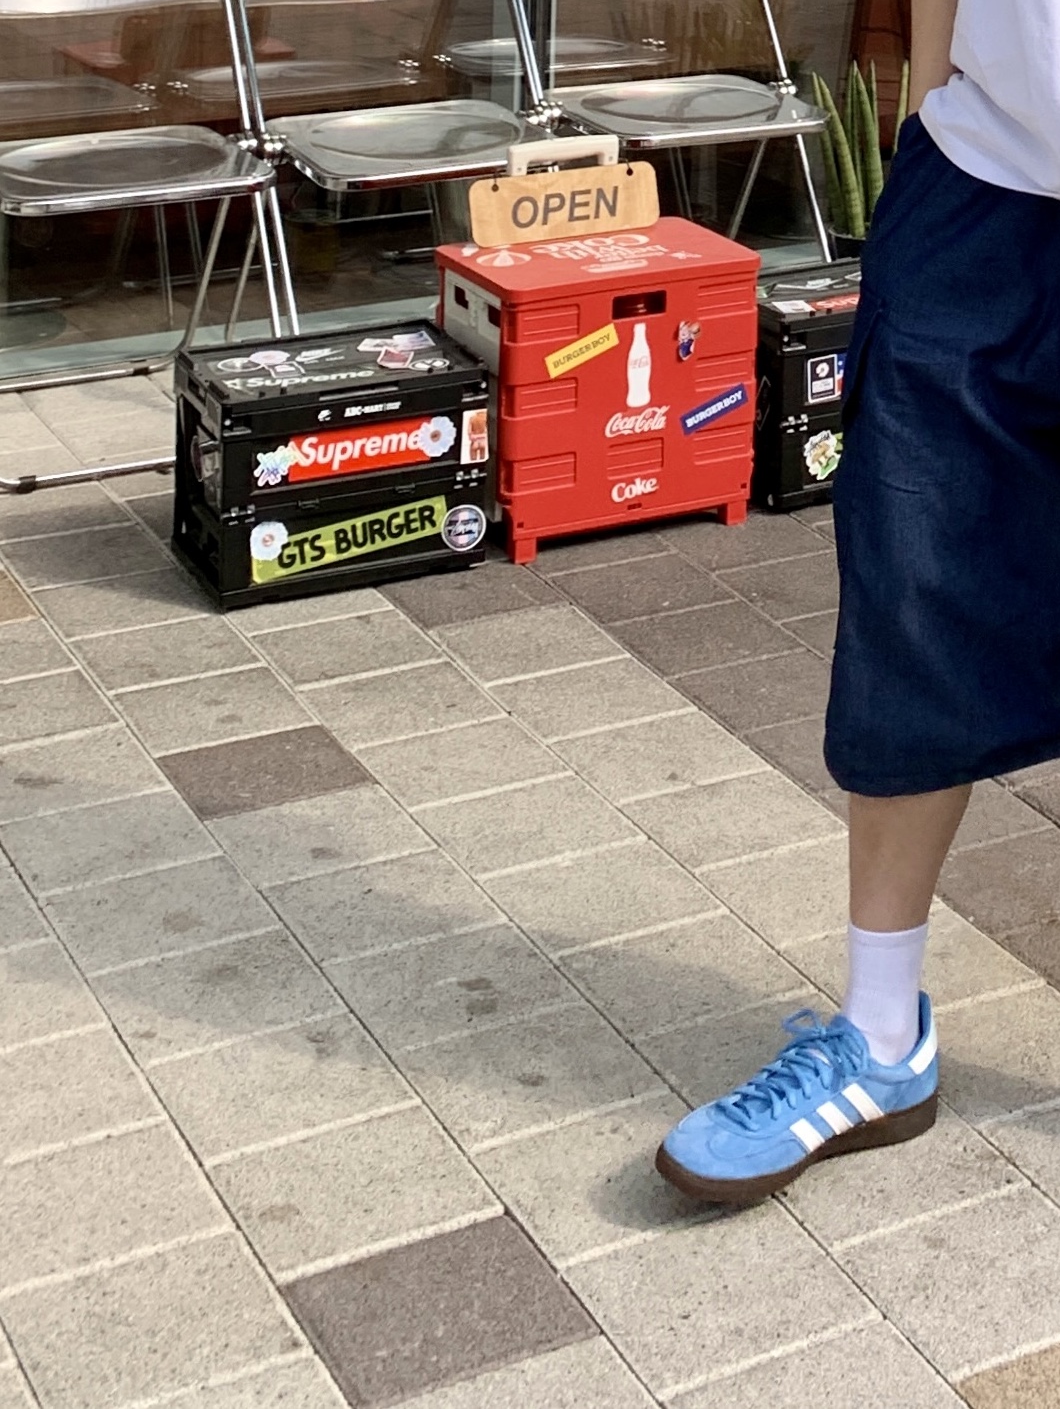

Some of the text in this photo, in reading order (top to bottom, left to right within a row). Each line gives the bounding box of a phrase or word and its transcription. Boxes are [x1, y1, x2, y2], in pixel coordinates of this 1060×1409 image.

[511, 186, 618, 228] OPEN
[245, 368, 375, 389] Supreme
[299, 430, 421, 471] Supreme
[611, 477, 660, 503] Coke
[277, 533, 326, 569] GTS
[334, 504, 437, 555] BURGER
